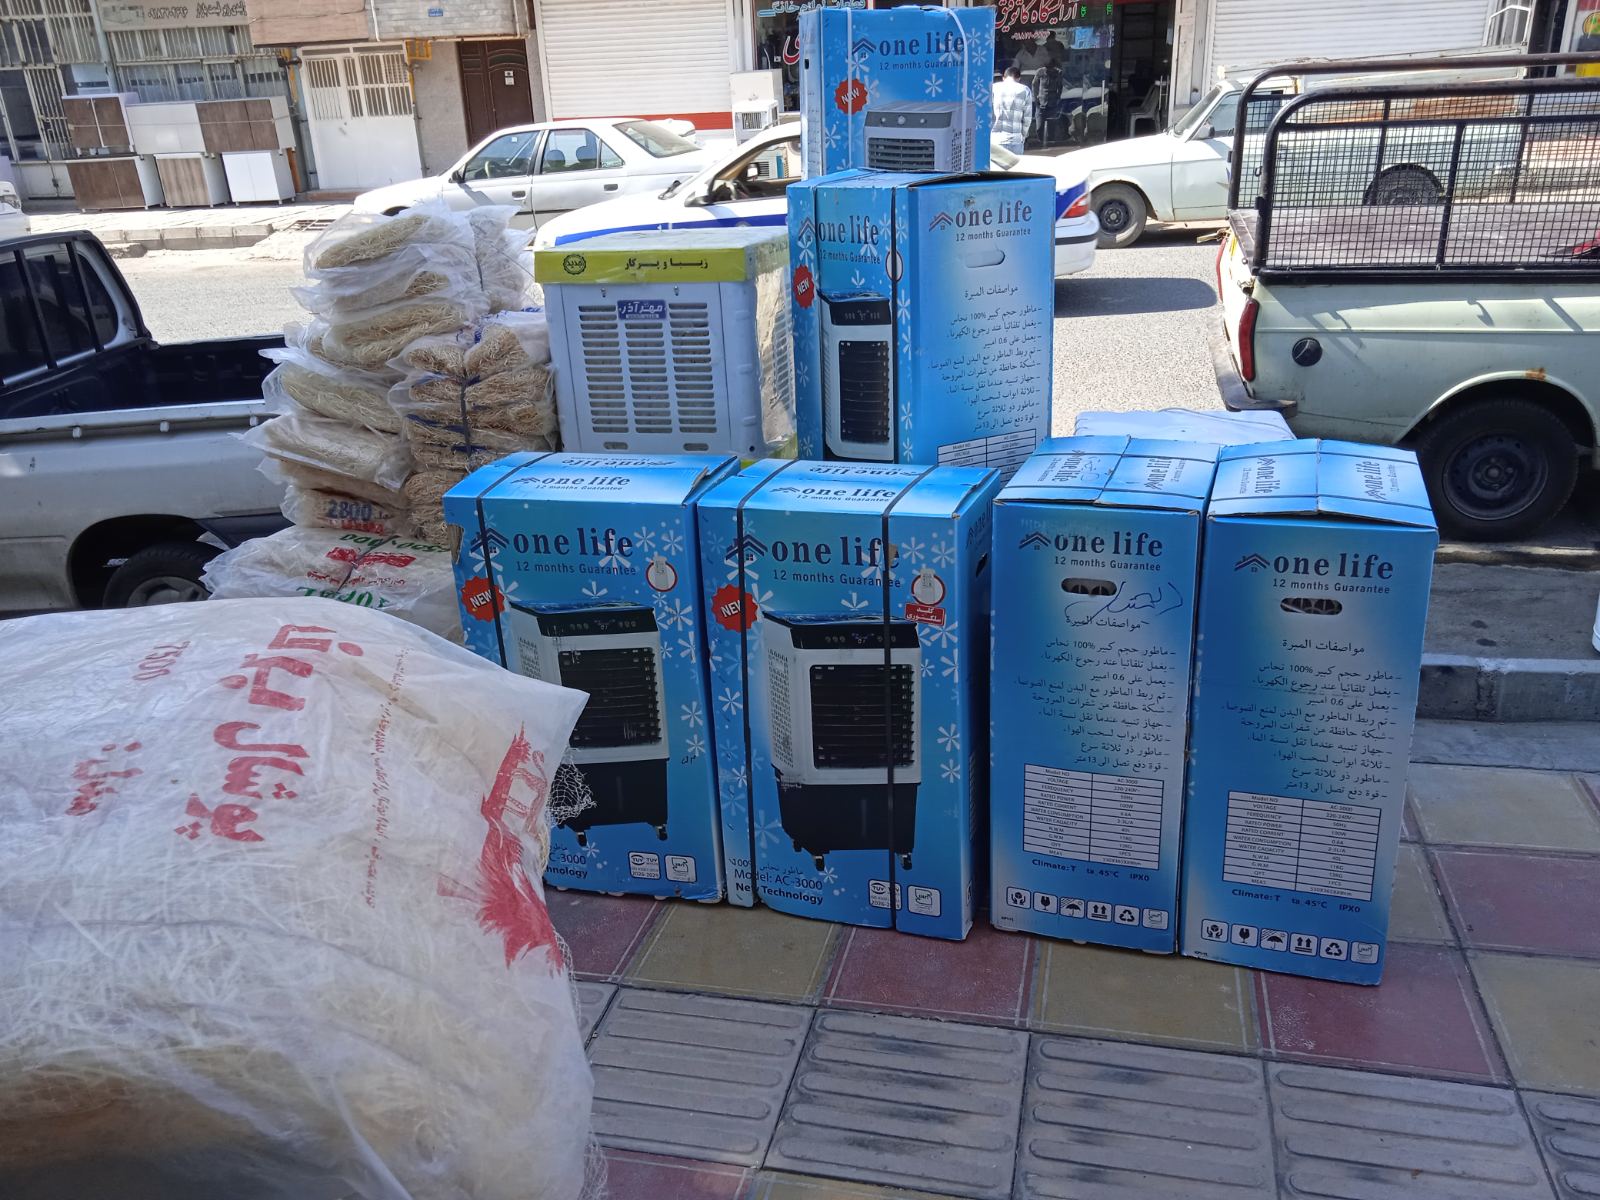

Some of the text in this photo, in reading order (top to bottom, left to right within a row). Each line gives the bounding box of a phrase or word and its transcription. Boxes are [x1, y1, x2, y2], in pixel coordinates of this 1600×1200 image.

[880, 31, 965, 56] one life
[956, 201, 1032, 228] one life
[819, 216, 879, 245] one life
[956, 228, 1031, 242] 12 months Guarantee
[850, 252, 880, 264] Guarantee
[797, 278, 809, 295] NEW
[542, 476, 630, 486] one life
[851, 487, 896, 497] life
[327, 500, 373, 520] 2800
[513, 527, 633, 557] one life
[1055, 531, 1163, 556] one life
[772, 540, 831, 564] one
[516, 561, 636, 576] 12 months Guarantee
[1055, 557, 1161, 571] 12 months Guarantee
[1273, 553, 1394, 580] one life
[772, 570, 901, 588] 12 months Guaranee
[1273, 579, 1390, 594] 12 months Guarantee
[470, 590, 491, 608] NEW
[1316, 640, 1364, 656] مواصفات
[549, 852, 586, 864] C-3000
[775, 875, 823, 890] AC-3000
[761, 886, 823, 905] Technology
[1339, 903, 1361, 912] IPX0
